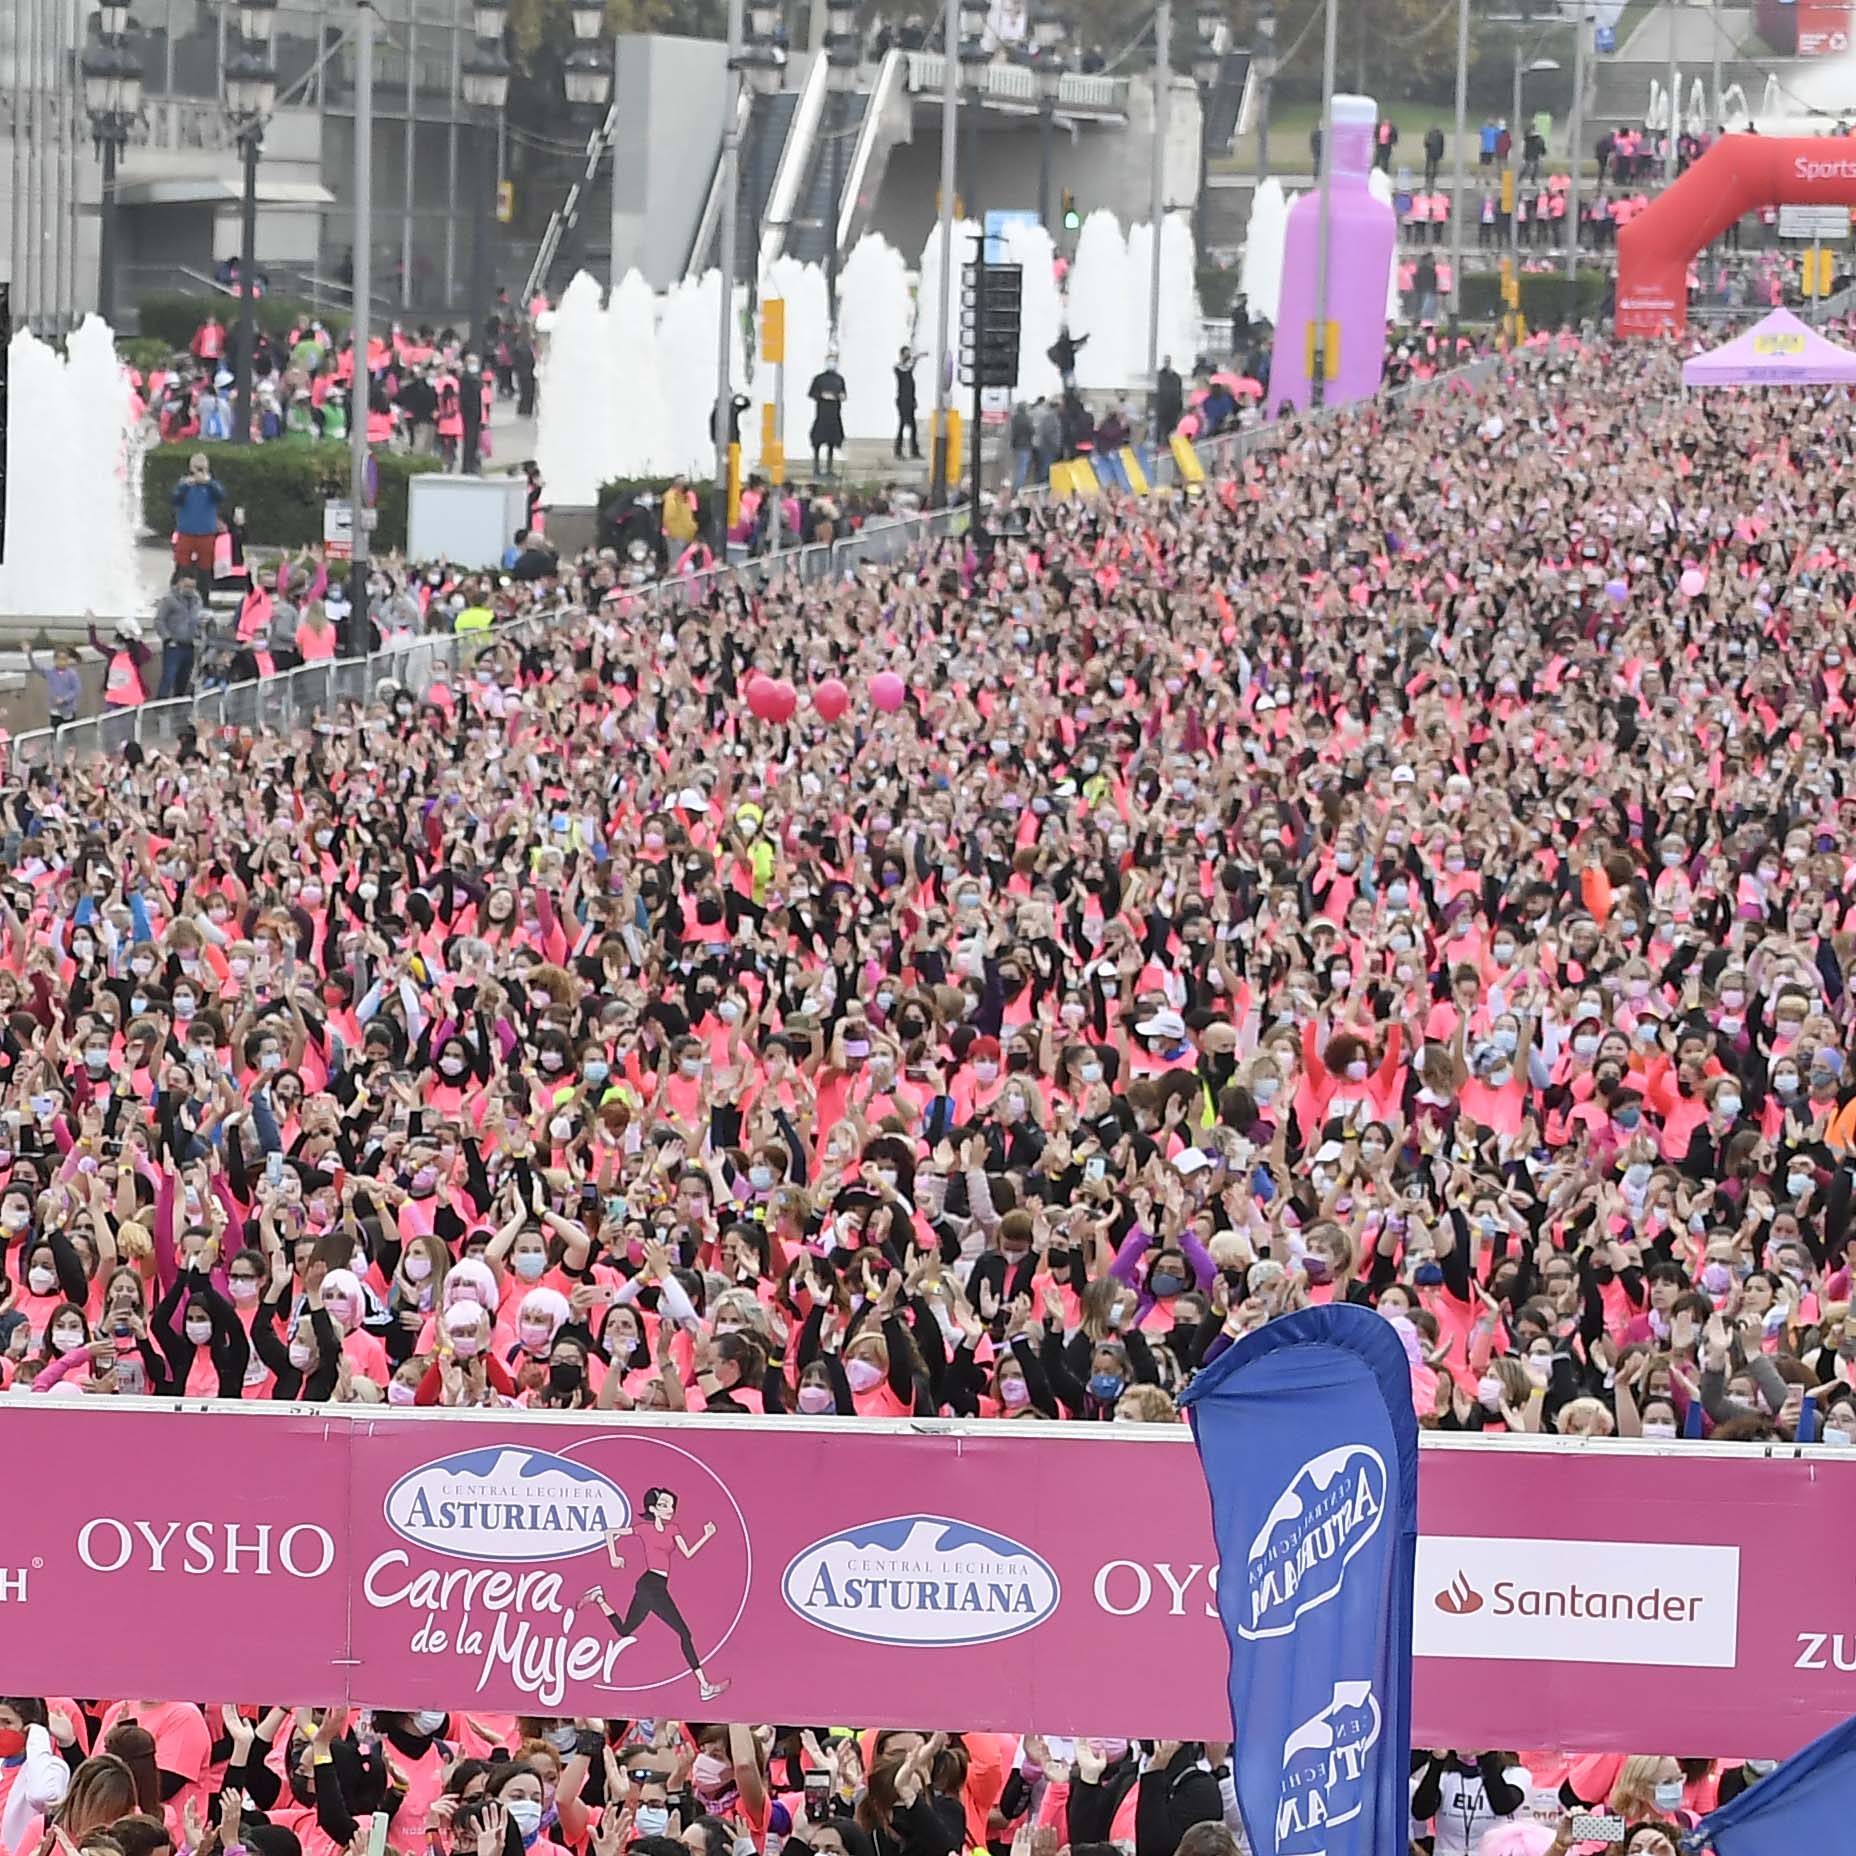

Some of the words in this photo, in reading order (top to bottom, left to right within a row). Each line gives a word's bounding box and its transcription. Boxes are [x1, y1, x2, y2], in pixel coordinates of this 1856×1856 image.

[404, 1484, 610, 1533] ASTURIANA
[440, 1483, 520, 1498] CENTRAL
[525, 1486, 604, 1500] LECHERA
[77, 1517, 336, 1579] OYSHO
[846, 1558, 933, 1573] CENTRAL
[940, 1560, 1029, 1576] LECHERA
[363, 1548, 564, 1615] Carrera
[803, 1560, 1037, 1614] ASTURIANA
[1492, 1582, 1703, 1623] Santander
[411, 1613, 448, 1655] de
[456, 1614, 483, 1656] la
[475, 1607, 637, 1707] Mujer
